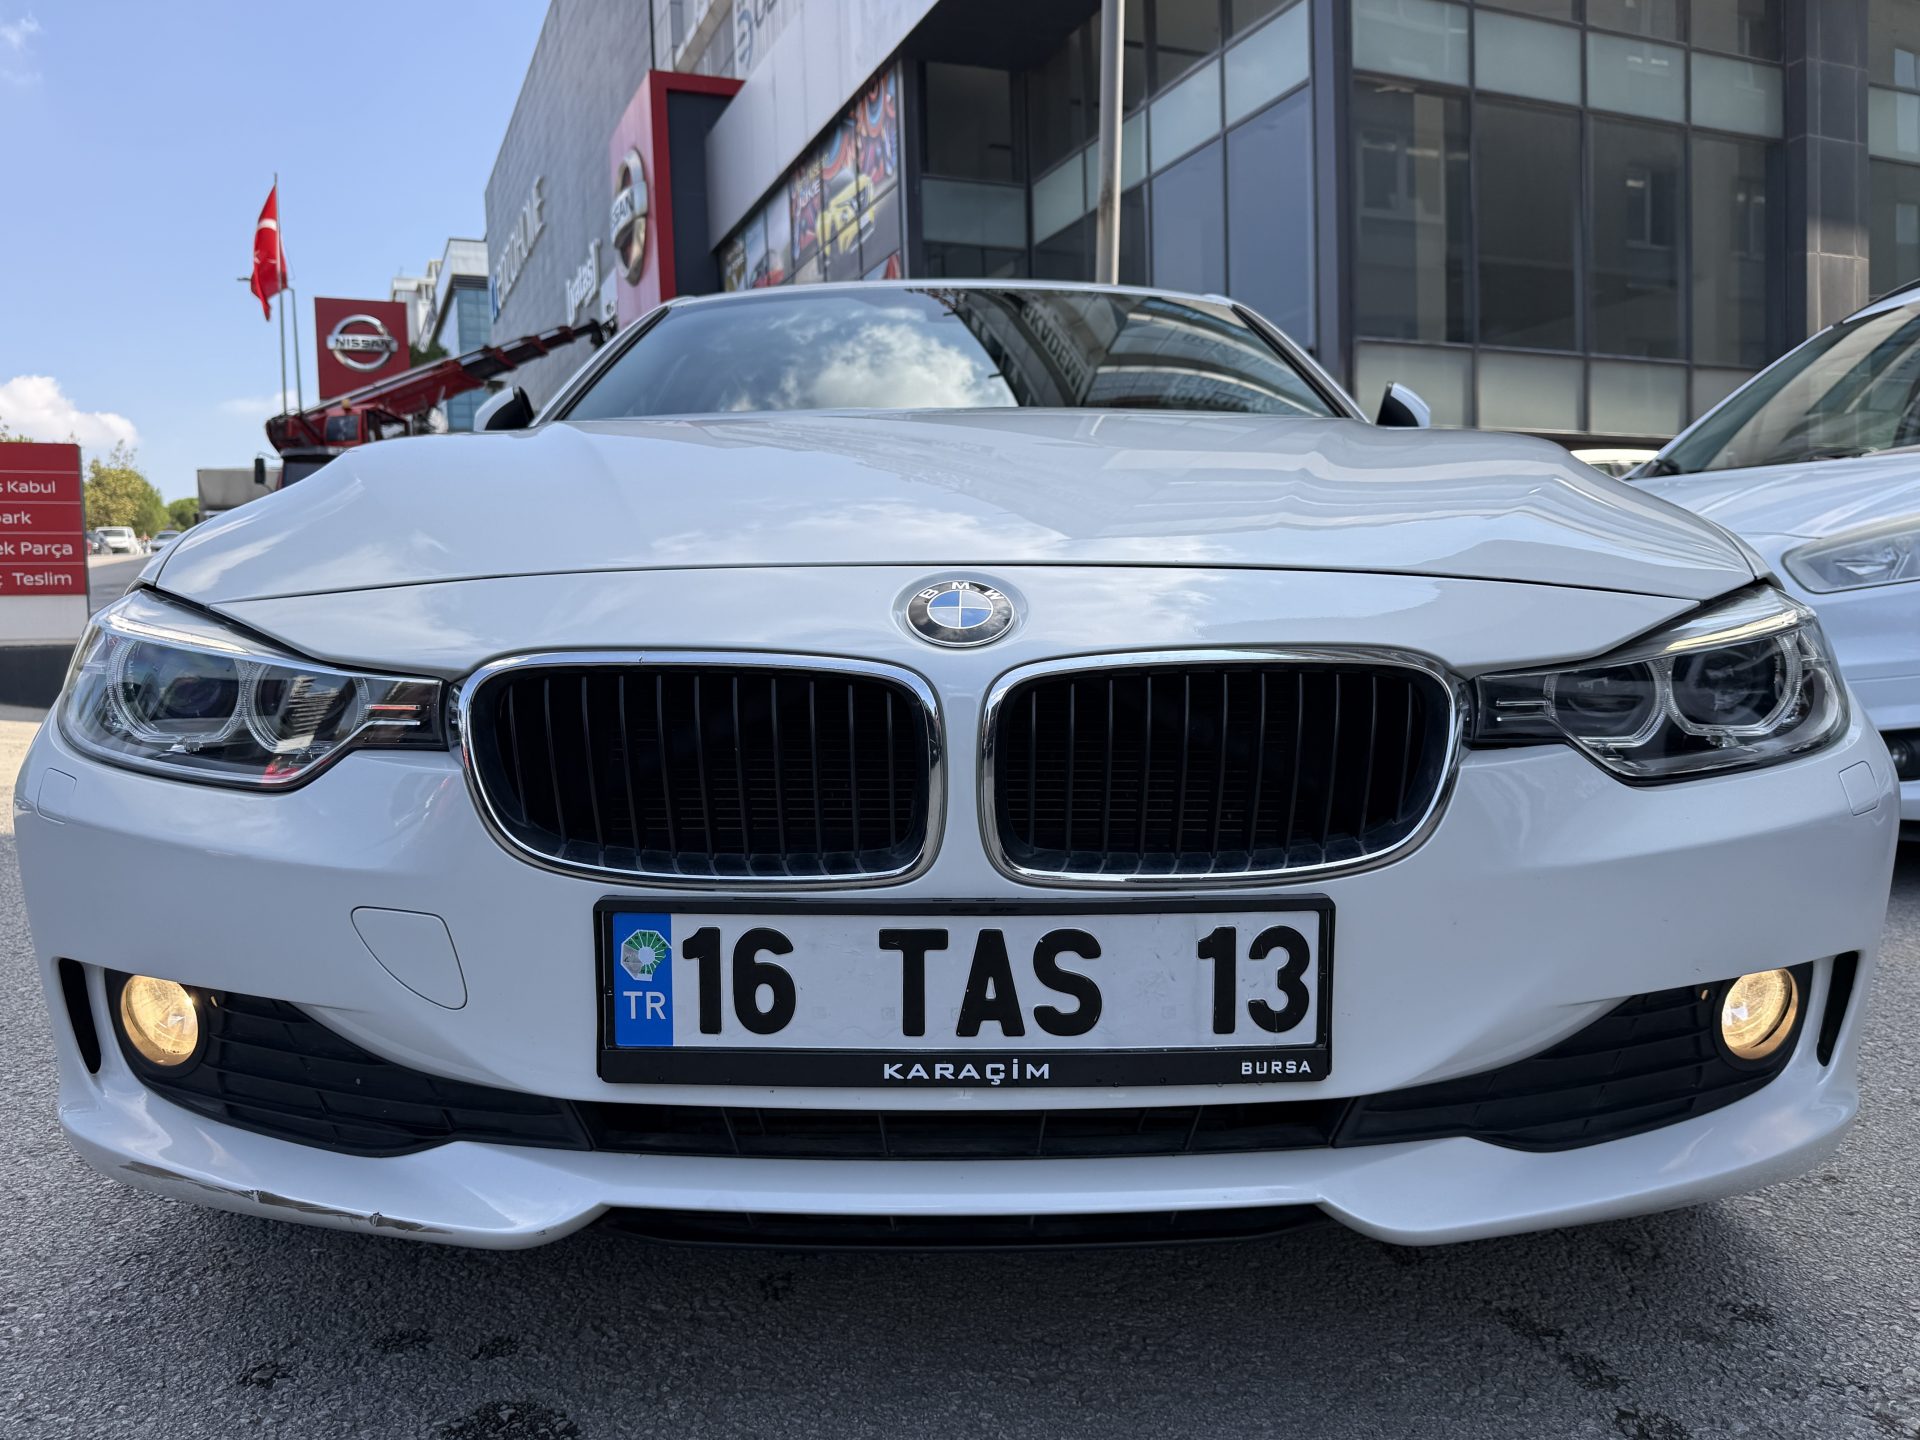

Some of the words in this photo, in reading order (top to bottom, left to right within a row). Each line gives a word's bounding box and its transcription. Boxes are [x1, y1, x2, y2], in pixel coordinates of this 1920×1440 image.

[335, 337, 392, 350] NISSAN
[7, 480, 56, 494] Kabul
[0, 511, 32, 525] ark
[21, 541, 73, 559] Parça
[12, 572, 72, 586] Teslim
[918, 581, 1005, 601] BMW
[623, 991, 667, 1020] TR
[681, 926, 797, 1036] 16
[878, 927, 1103, 1038] TAS
[1197, 924, 1312, 1036] 13
[883, 1058, 1050, 1086] KARAÇİM
[1240, 1060, 1312, 1076] BURSA
